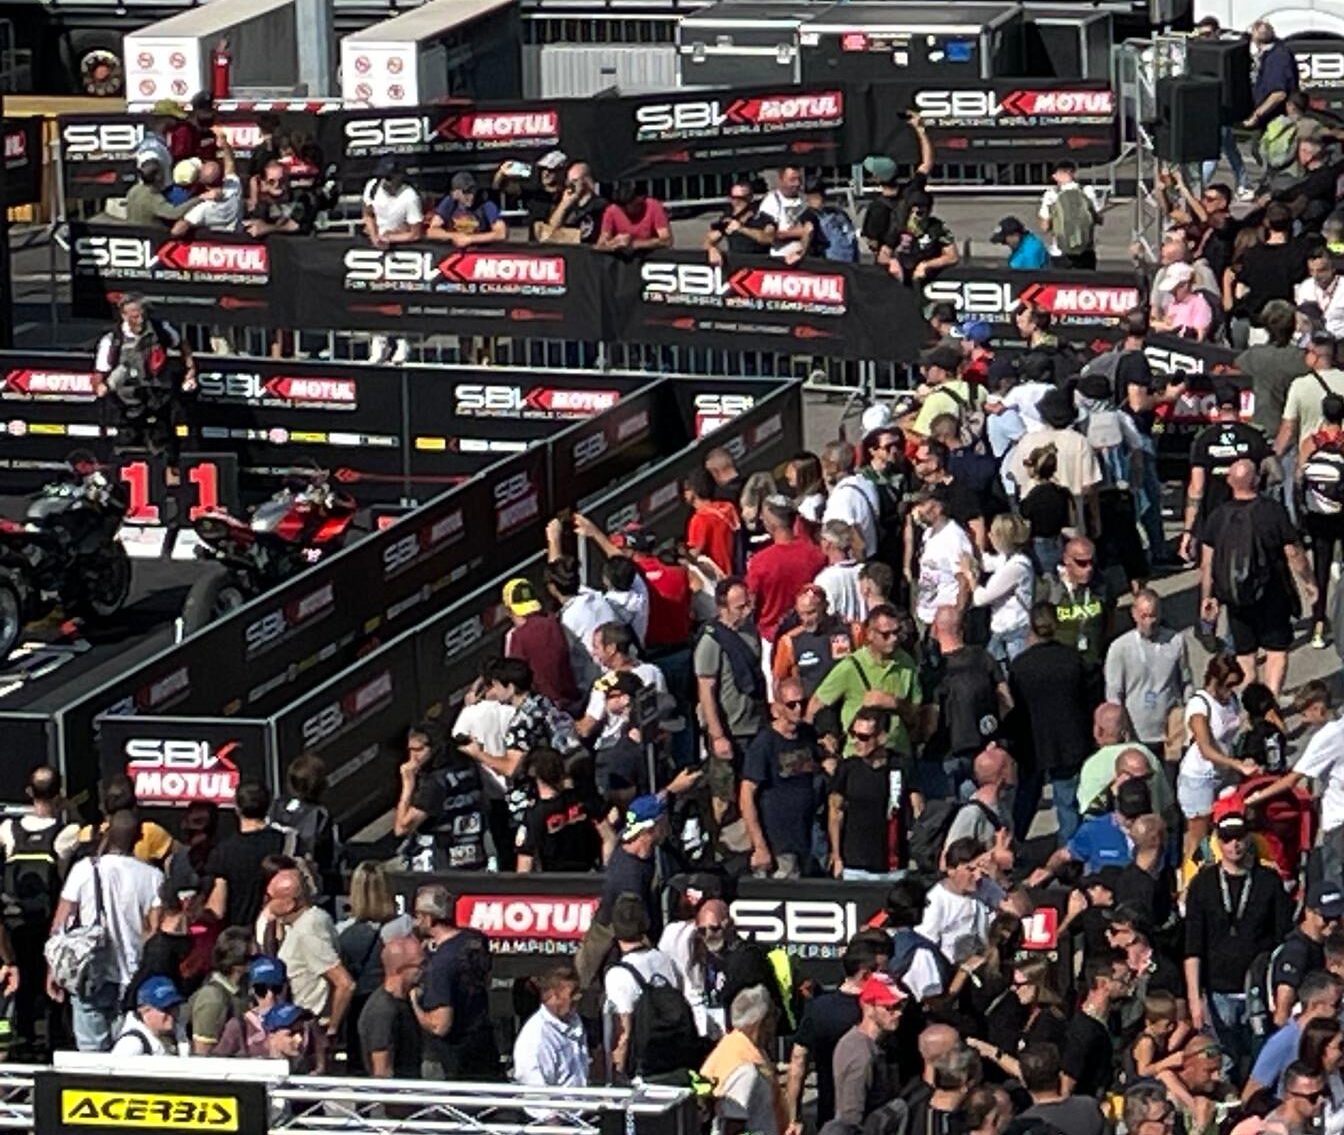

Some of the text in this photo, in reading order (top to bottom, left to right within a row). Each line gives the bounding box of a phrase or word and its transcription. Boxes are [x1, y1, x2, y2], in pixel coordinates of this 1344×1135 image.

[636, 95, 840, 134] SBK MOTUL
[915, 90, 1112, 118] SBK MOTUL
[345, 113, 556, 147] SBK MOTUL
[75, 237, 267, 270] SBK MOTUL
[344, 249, 562, 282] SBK MOTUL
[641, 262, 843, 302] SBK MOTUL
[923, 281, 1038, 313] SBK
[29, 373, 93, 392] MOTUL
[199, 372, 355, 399] SBK MOTUL
[455, 385, 542, 410] SBK
[121, 462, 160, 521] 1
[189, 462, 228, 521] 1
[126, 738, 242, 769] SBK
[134, 772, 237, 799] MOTUL
[489, 939, 577, 955] HAMPIONS
[68, 1097, 233, 1125] ACERBIS
